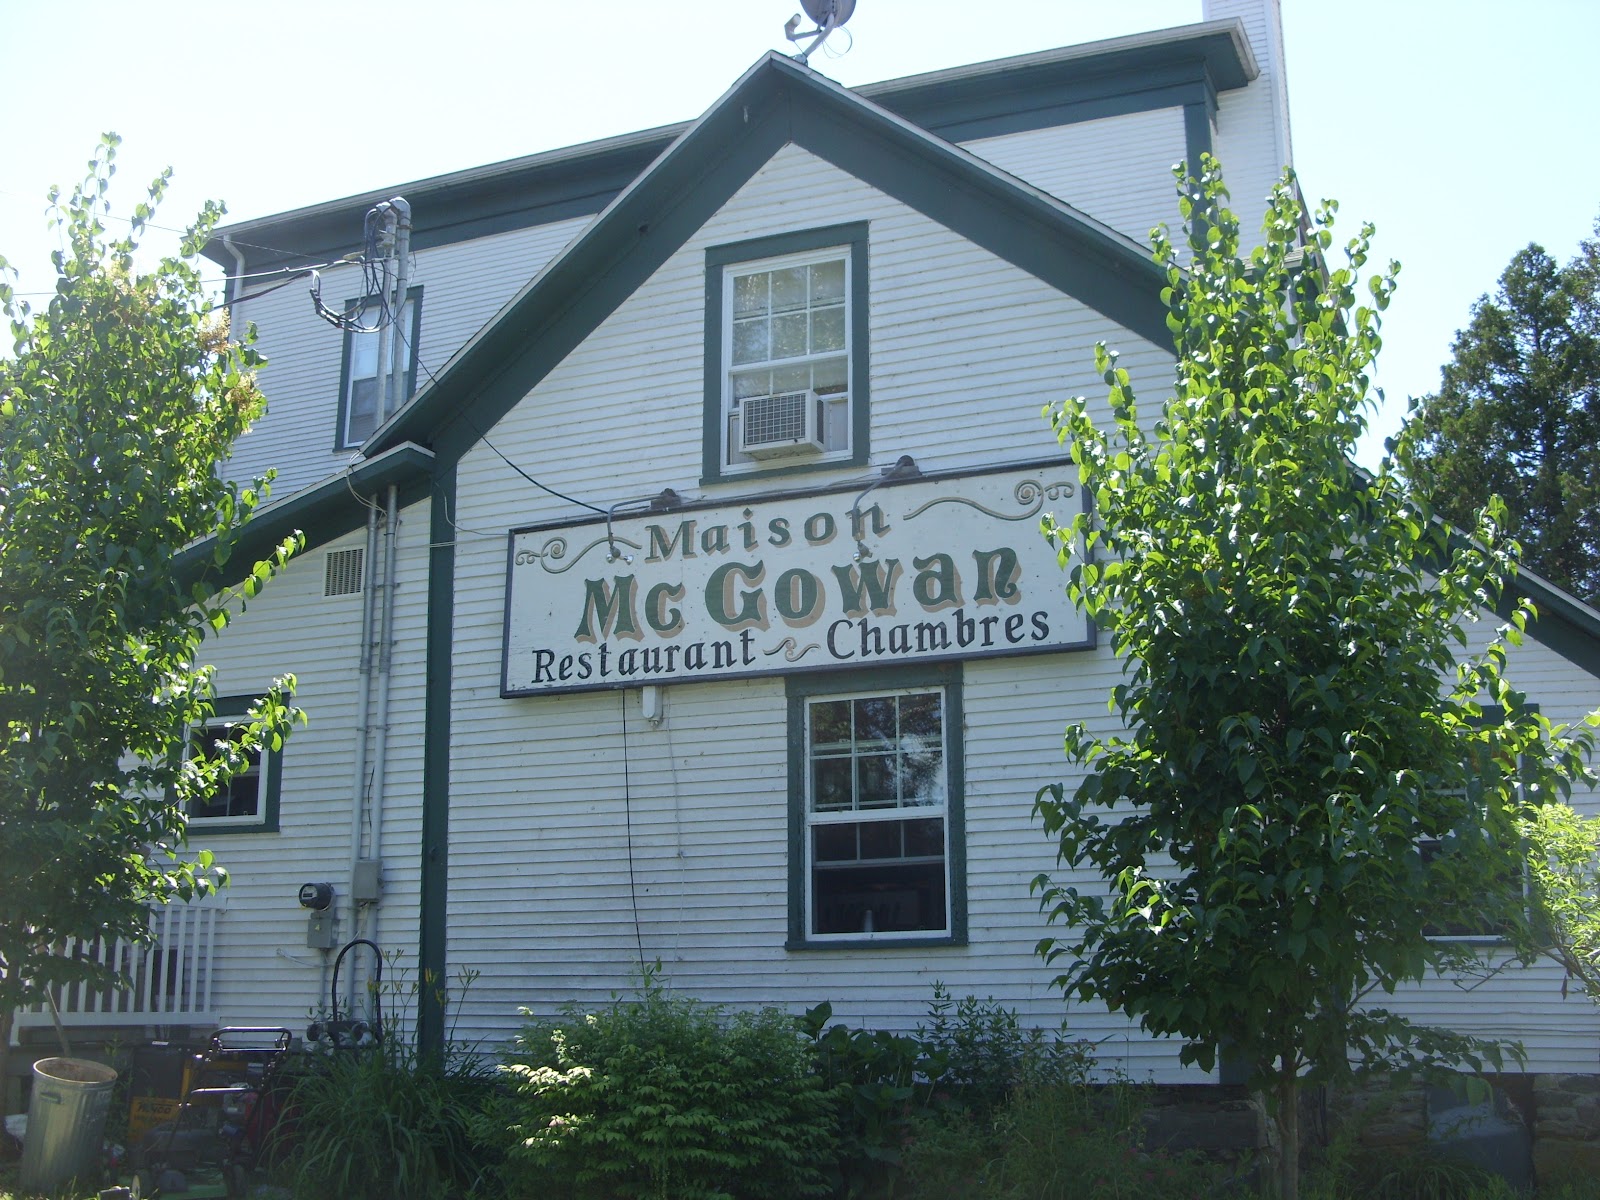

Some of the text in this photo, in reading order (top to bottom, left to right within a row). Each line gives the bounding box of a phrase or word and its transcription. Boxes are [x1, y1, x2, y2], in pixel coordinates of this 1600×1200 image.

[644, 503, 892, 563] Maison
[531, 608, 1050, 684] Restaurant Chambres
